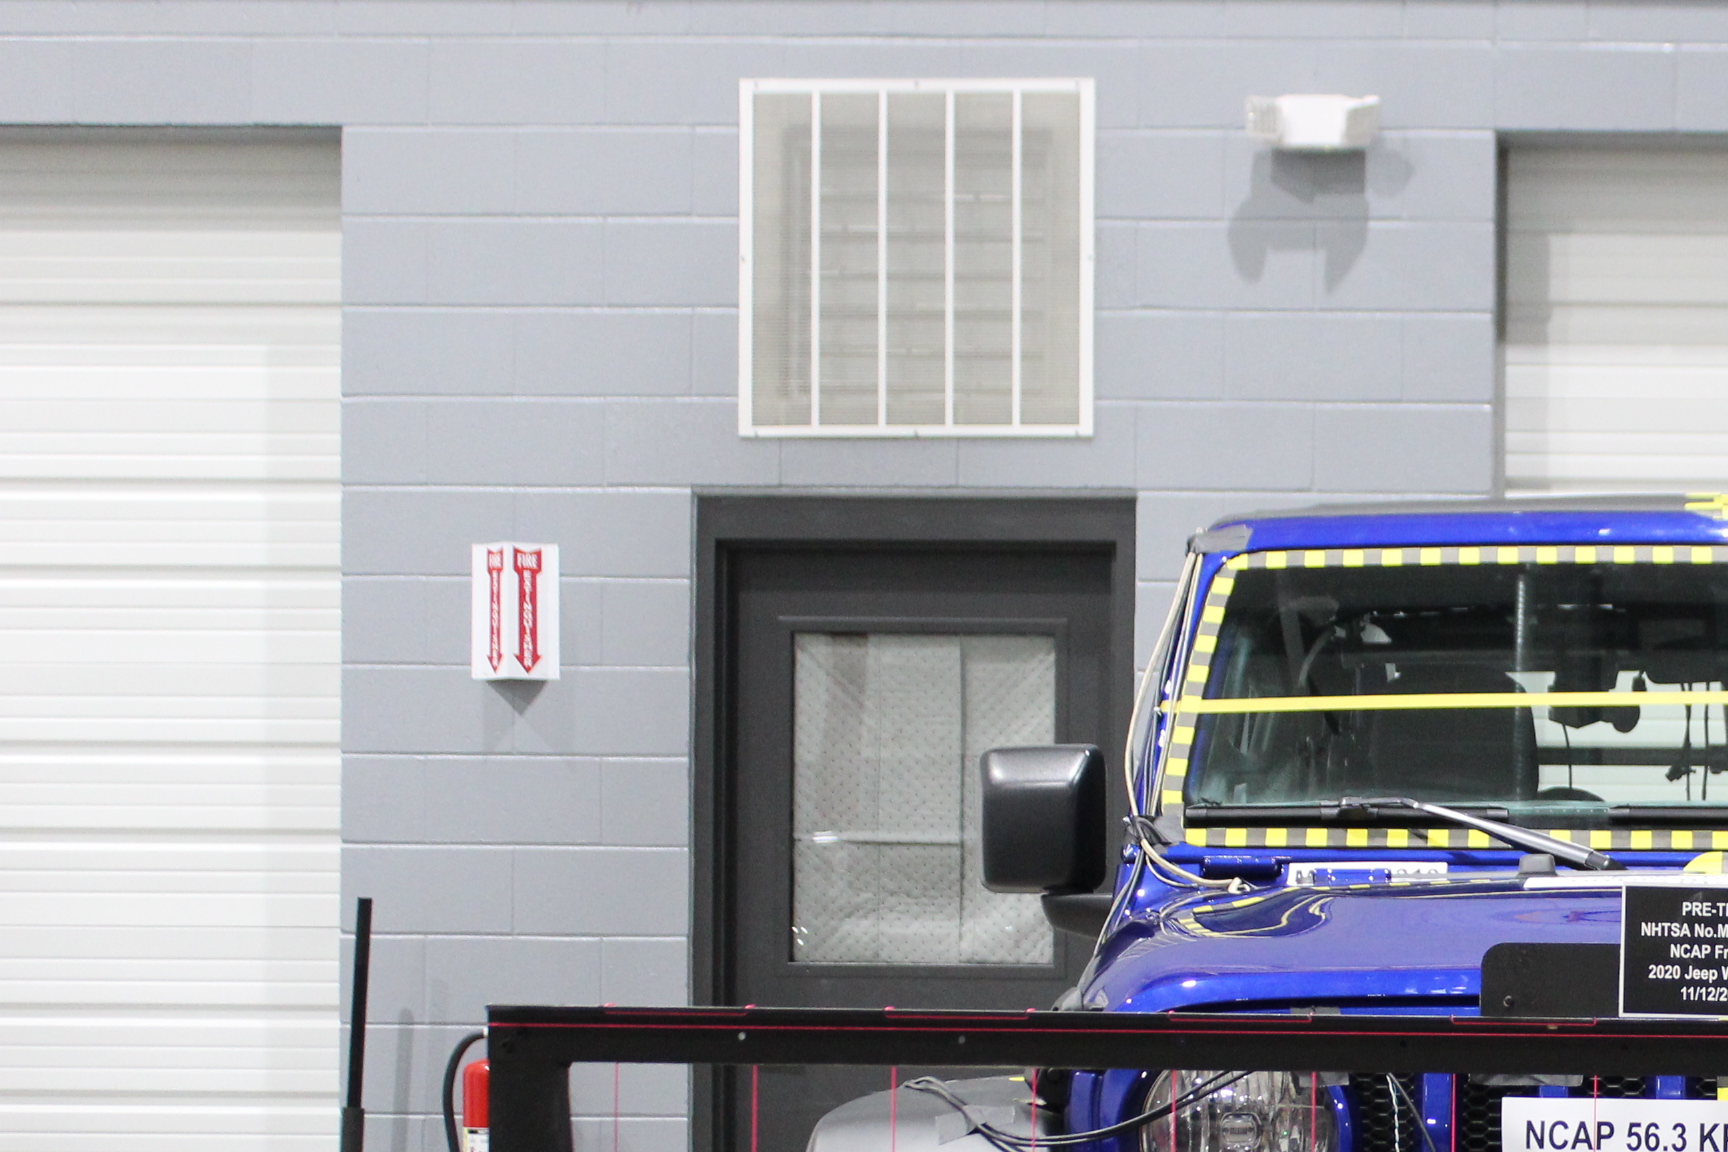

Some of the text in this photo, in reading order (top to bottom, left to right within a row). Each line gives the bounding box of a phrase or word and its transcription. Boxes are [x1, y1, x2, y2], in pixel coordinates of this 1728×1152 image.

[516, 553, 538, 569] FIRE
[1641, 922, 1691, 937] NHTSA
[1670, 944, 1711, 959] NCAP
[1648, 965, 1681, 979] 2020
[1685, 966, 1718, 983] Jeep
[1525, 1120, 1616, 1151] NCAP
[1626, 1122, 1687, 1152] 56.3
